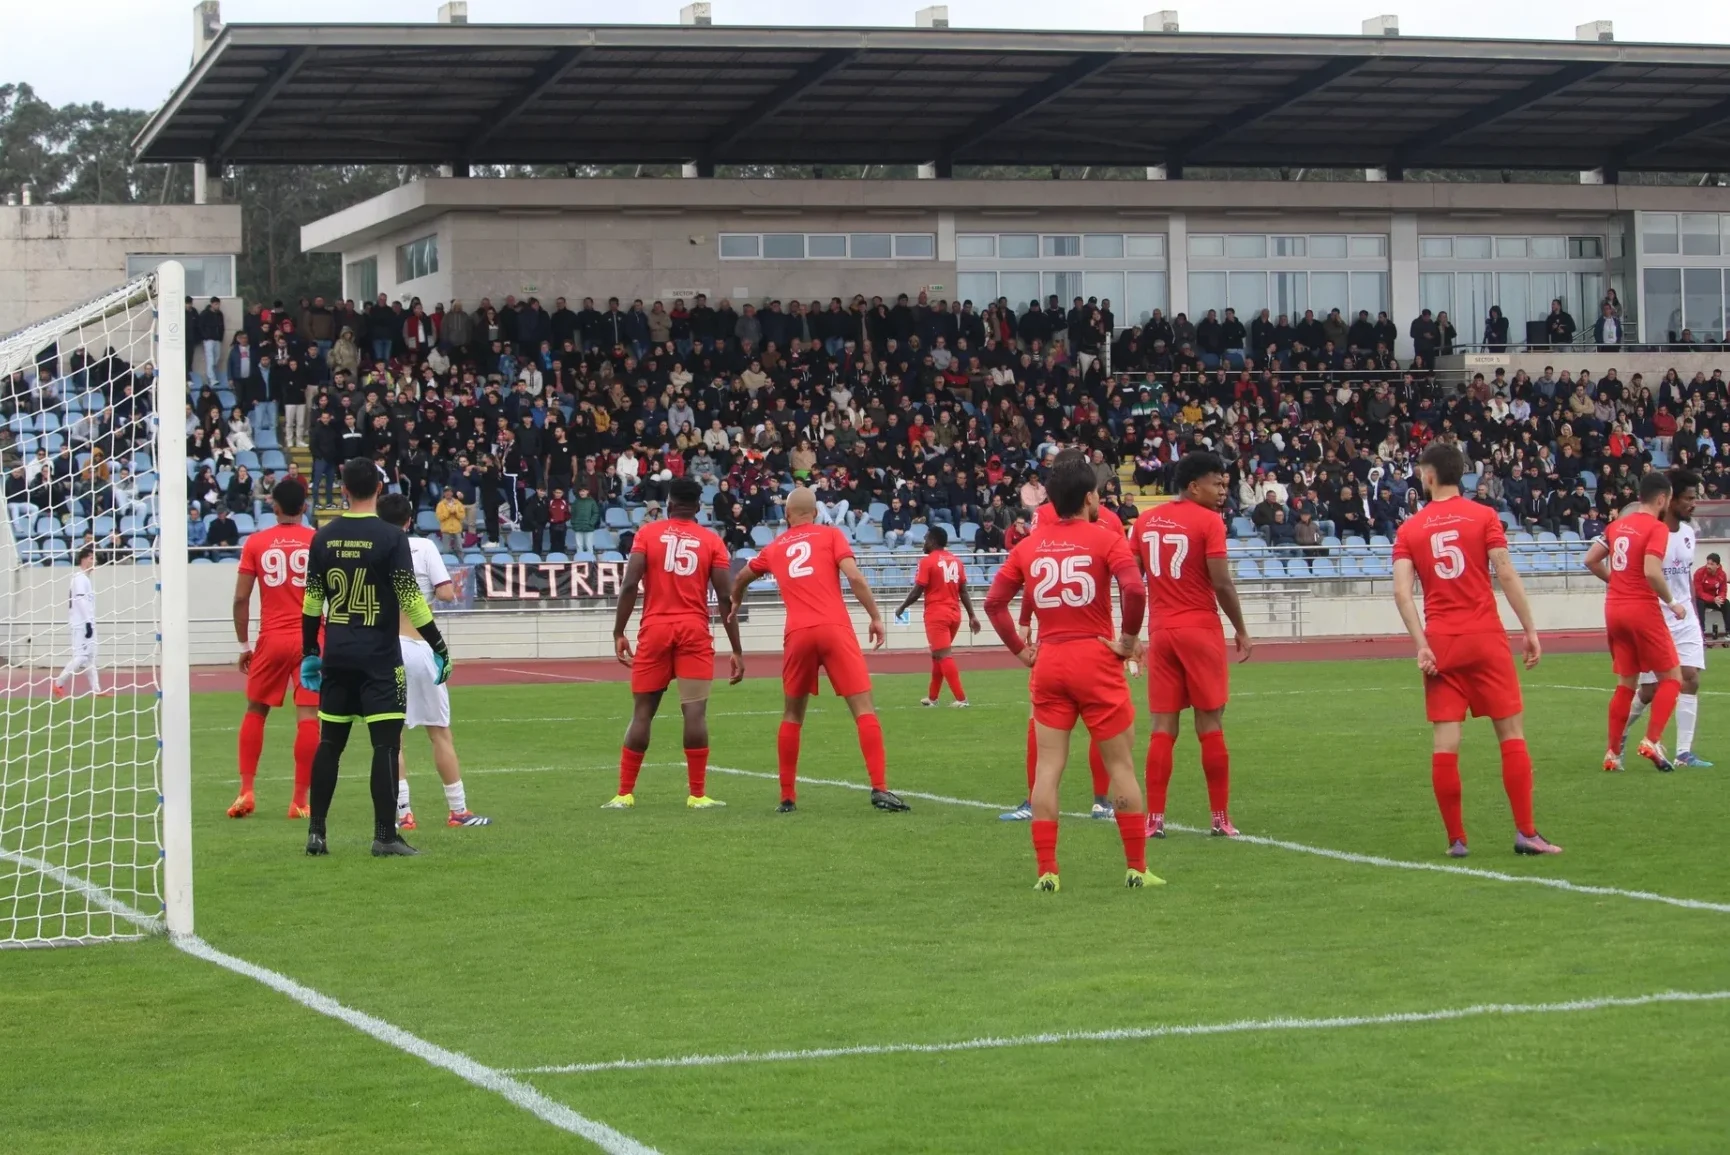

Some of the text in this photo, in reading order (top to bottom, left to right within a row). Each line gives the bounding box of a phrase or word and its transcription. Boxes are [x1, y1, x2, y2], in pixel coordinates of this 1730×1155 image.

[326, 540, 342, 549] SPORT
[341, 550, 361, 558] BENFICA
[660, 534, 700, 576] 15
[786, 541, 814, 578] 2
[1142, 531, 1188, 579] 17
[1430, 530, 1465, 579] 5
[1612, 536, 1629, 571] 8
[261, 548, 309, 587] 99
[937, 560, 959, 583] 14
[1030, 555, 1096, 608] 25
[327, 567, 380, 626] 24
